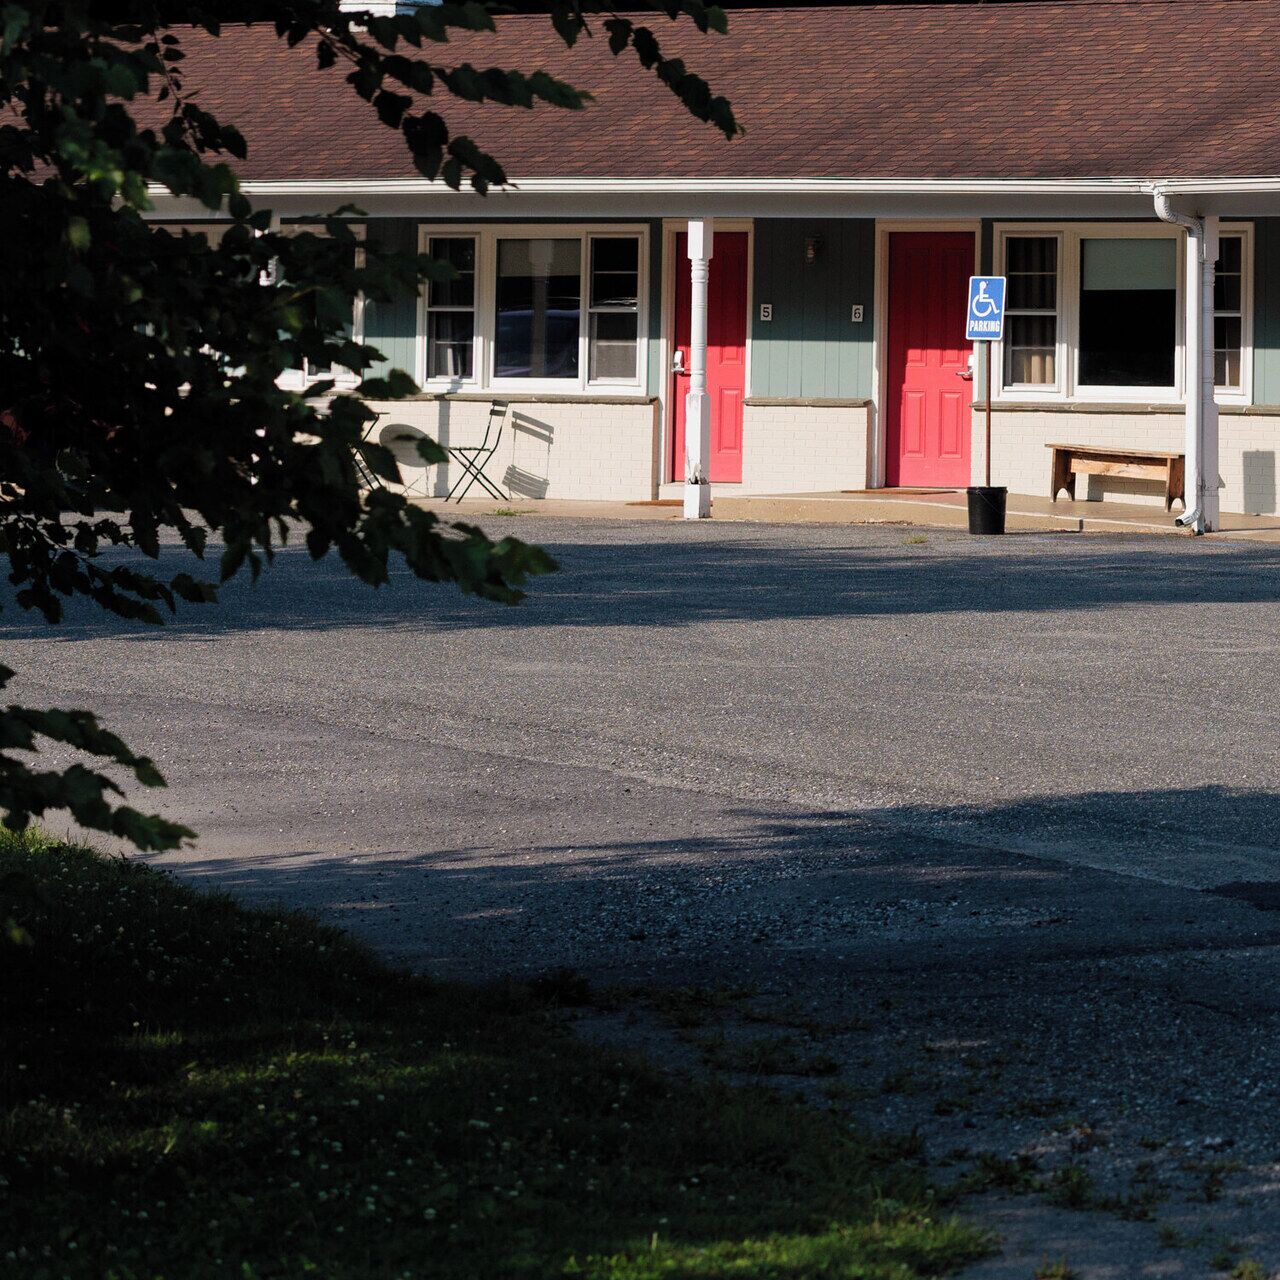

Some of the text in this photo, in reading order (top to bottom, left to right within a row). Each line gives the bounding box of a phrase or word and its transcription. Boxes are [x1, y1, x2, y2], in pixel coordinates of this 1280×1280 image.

[762, 307, 770, 318] 5
[853, 307, 861, 319] 6
[969, 320, 1000, 332] PARKING
